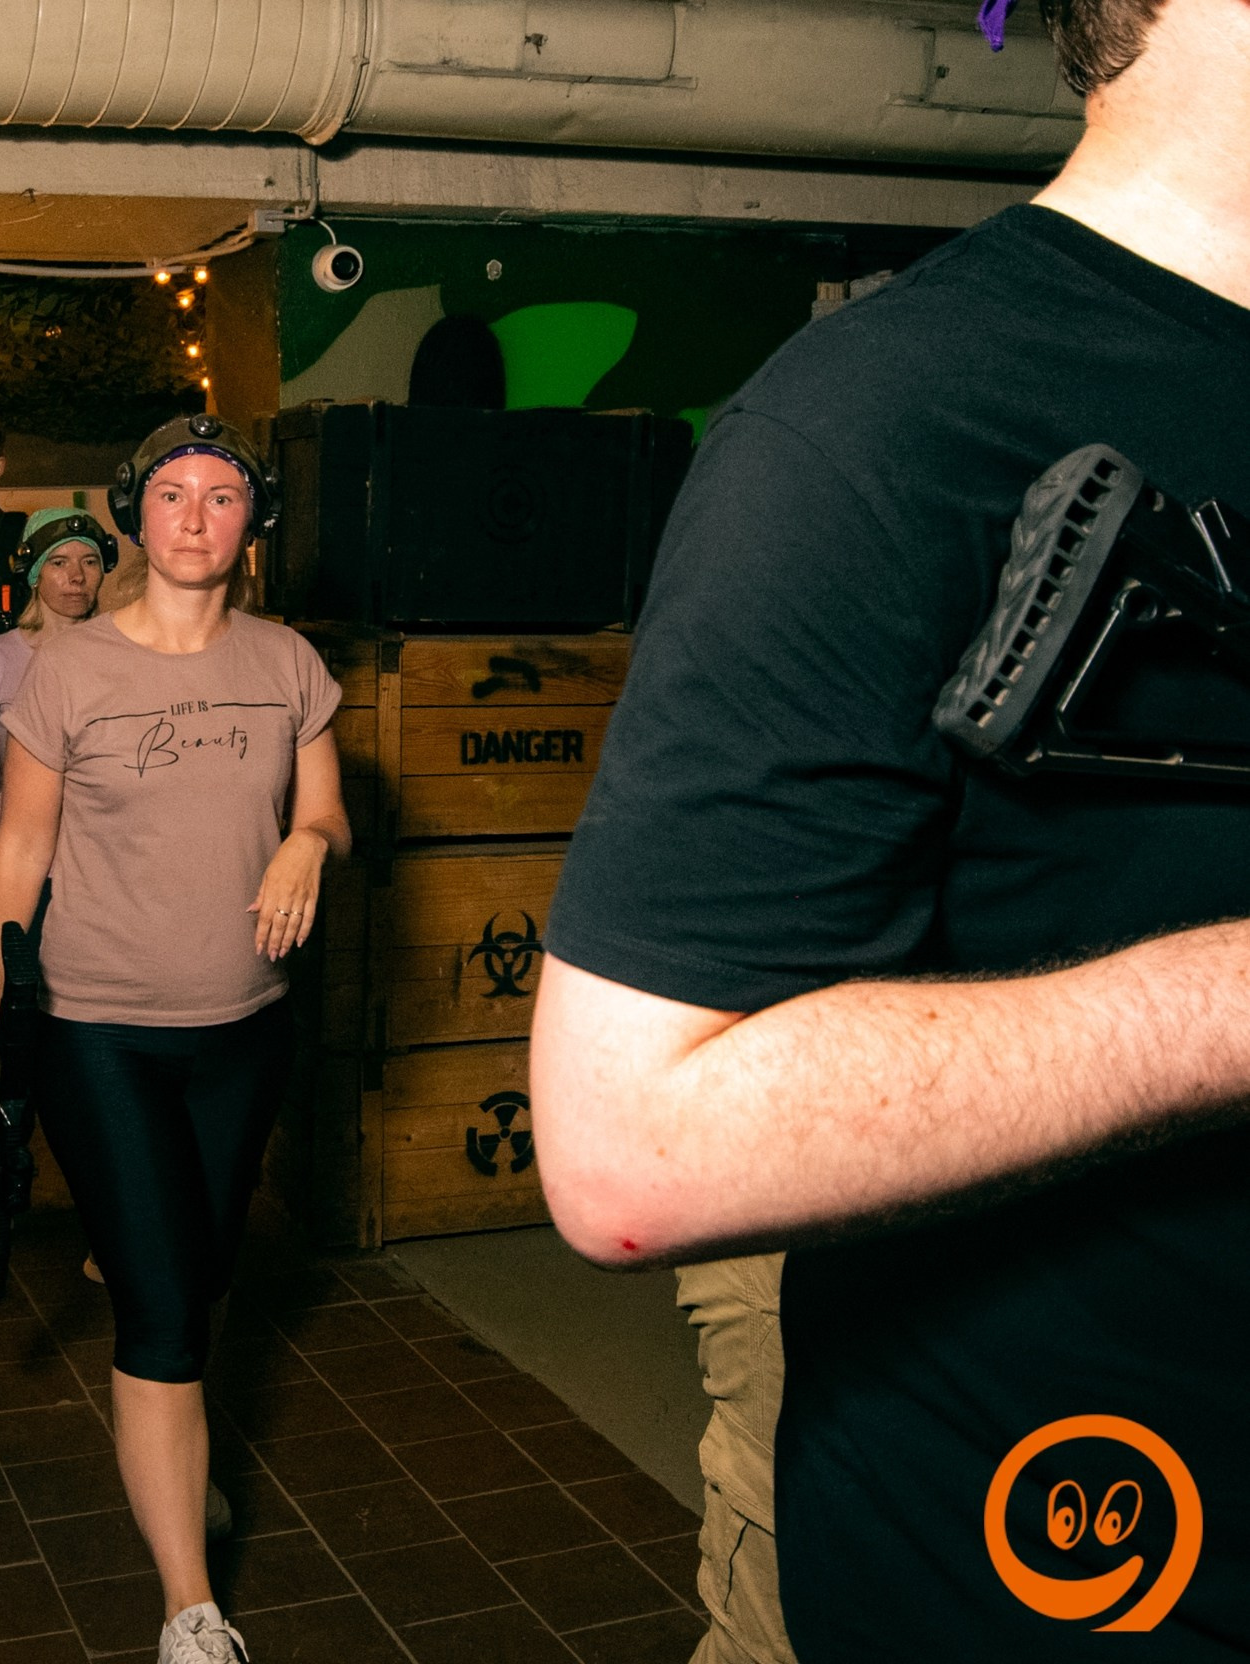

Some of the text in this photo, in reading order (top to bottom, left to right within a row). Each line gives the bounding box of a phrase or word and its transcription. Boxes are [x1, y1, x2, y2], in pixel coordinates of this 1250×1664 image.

[170, 700, 209, 716] LIFE IS
[123, 717, 248, 778] Beauty
[461, 730, 584, 766] DANGER
